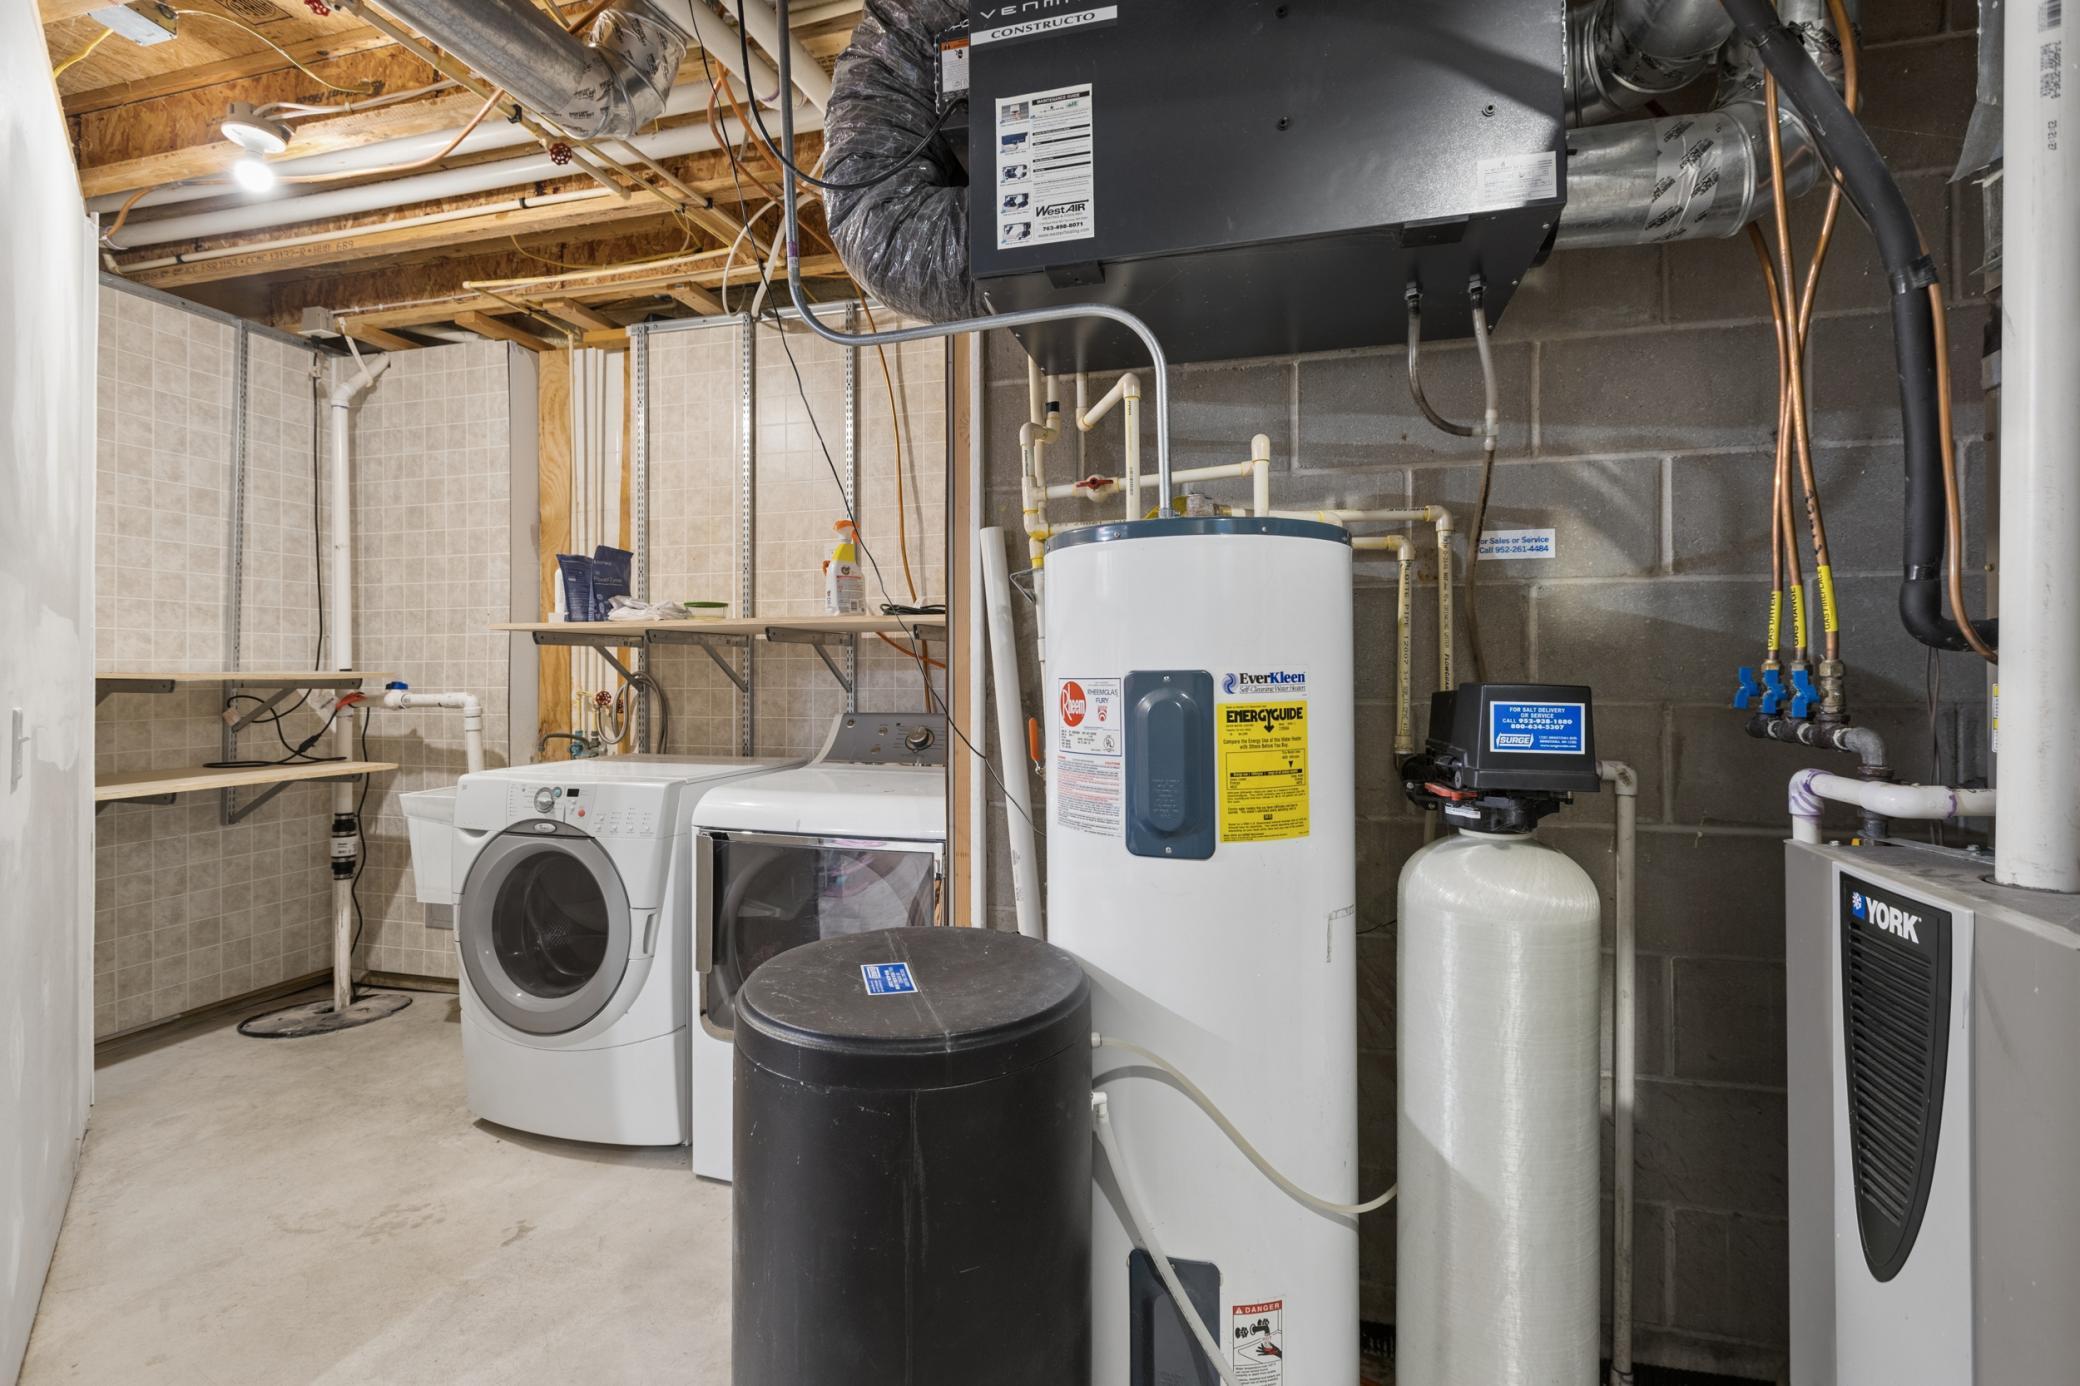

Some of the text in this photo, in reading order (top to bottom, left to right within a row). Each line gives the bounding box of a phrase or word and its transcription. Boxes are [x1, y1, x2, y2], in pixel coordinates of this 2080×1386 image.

[991, 12, 1096, 39] CONSTRUCTO
[1521, 536, 1549, 544] Service
[1239, 671, 1305, 685] EverKleen
[1061, 683, 1086, 722] Rheem
[1226, 706, 1303, 724] ENERGYGUIDE
[1499, 736, 1531, 744] SURGE
[1865, 896, 1919, 944] YORK
[1244, 1302, 1280, 1314] DANGER
